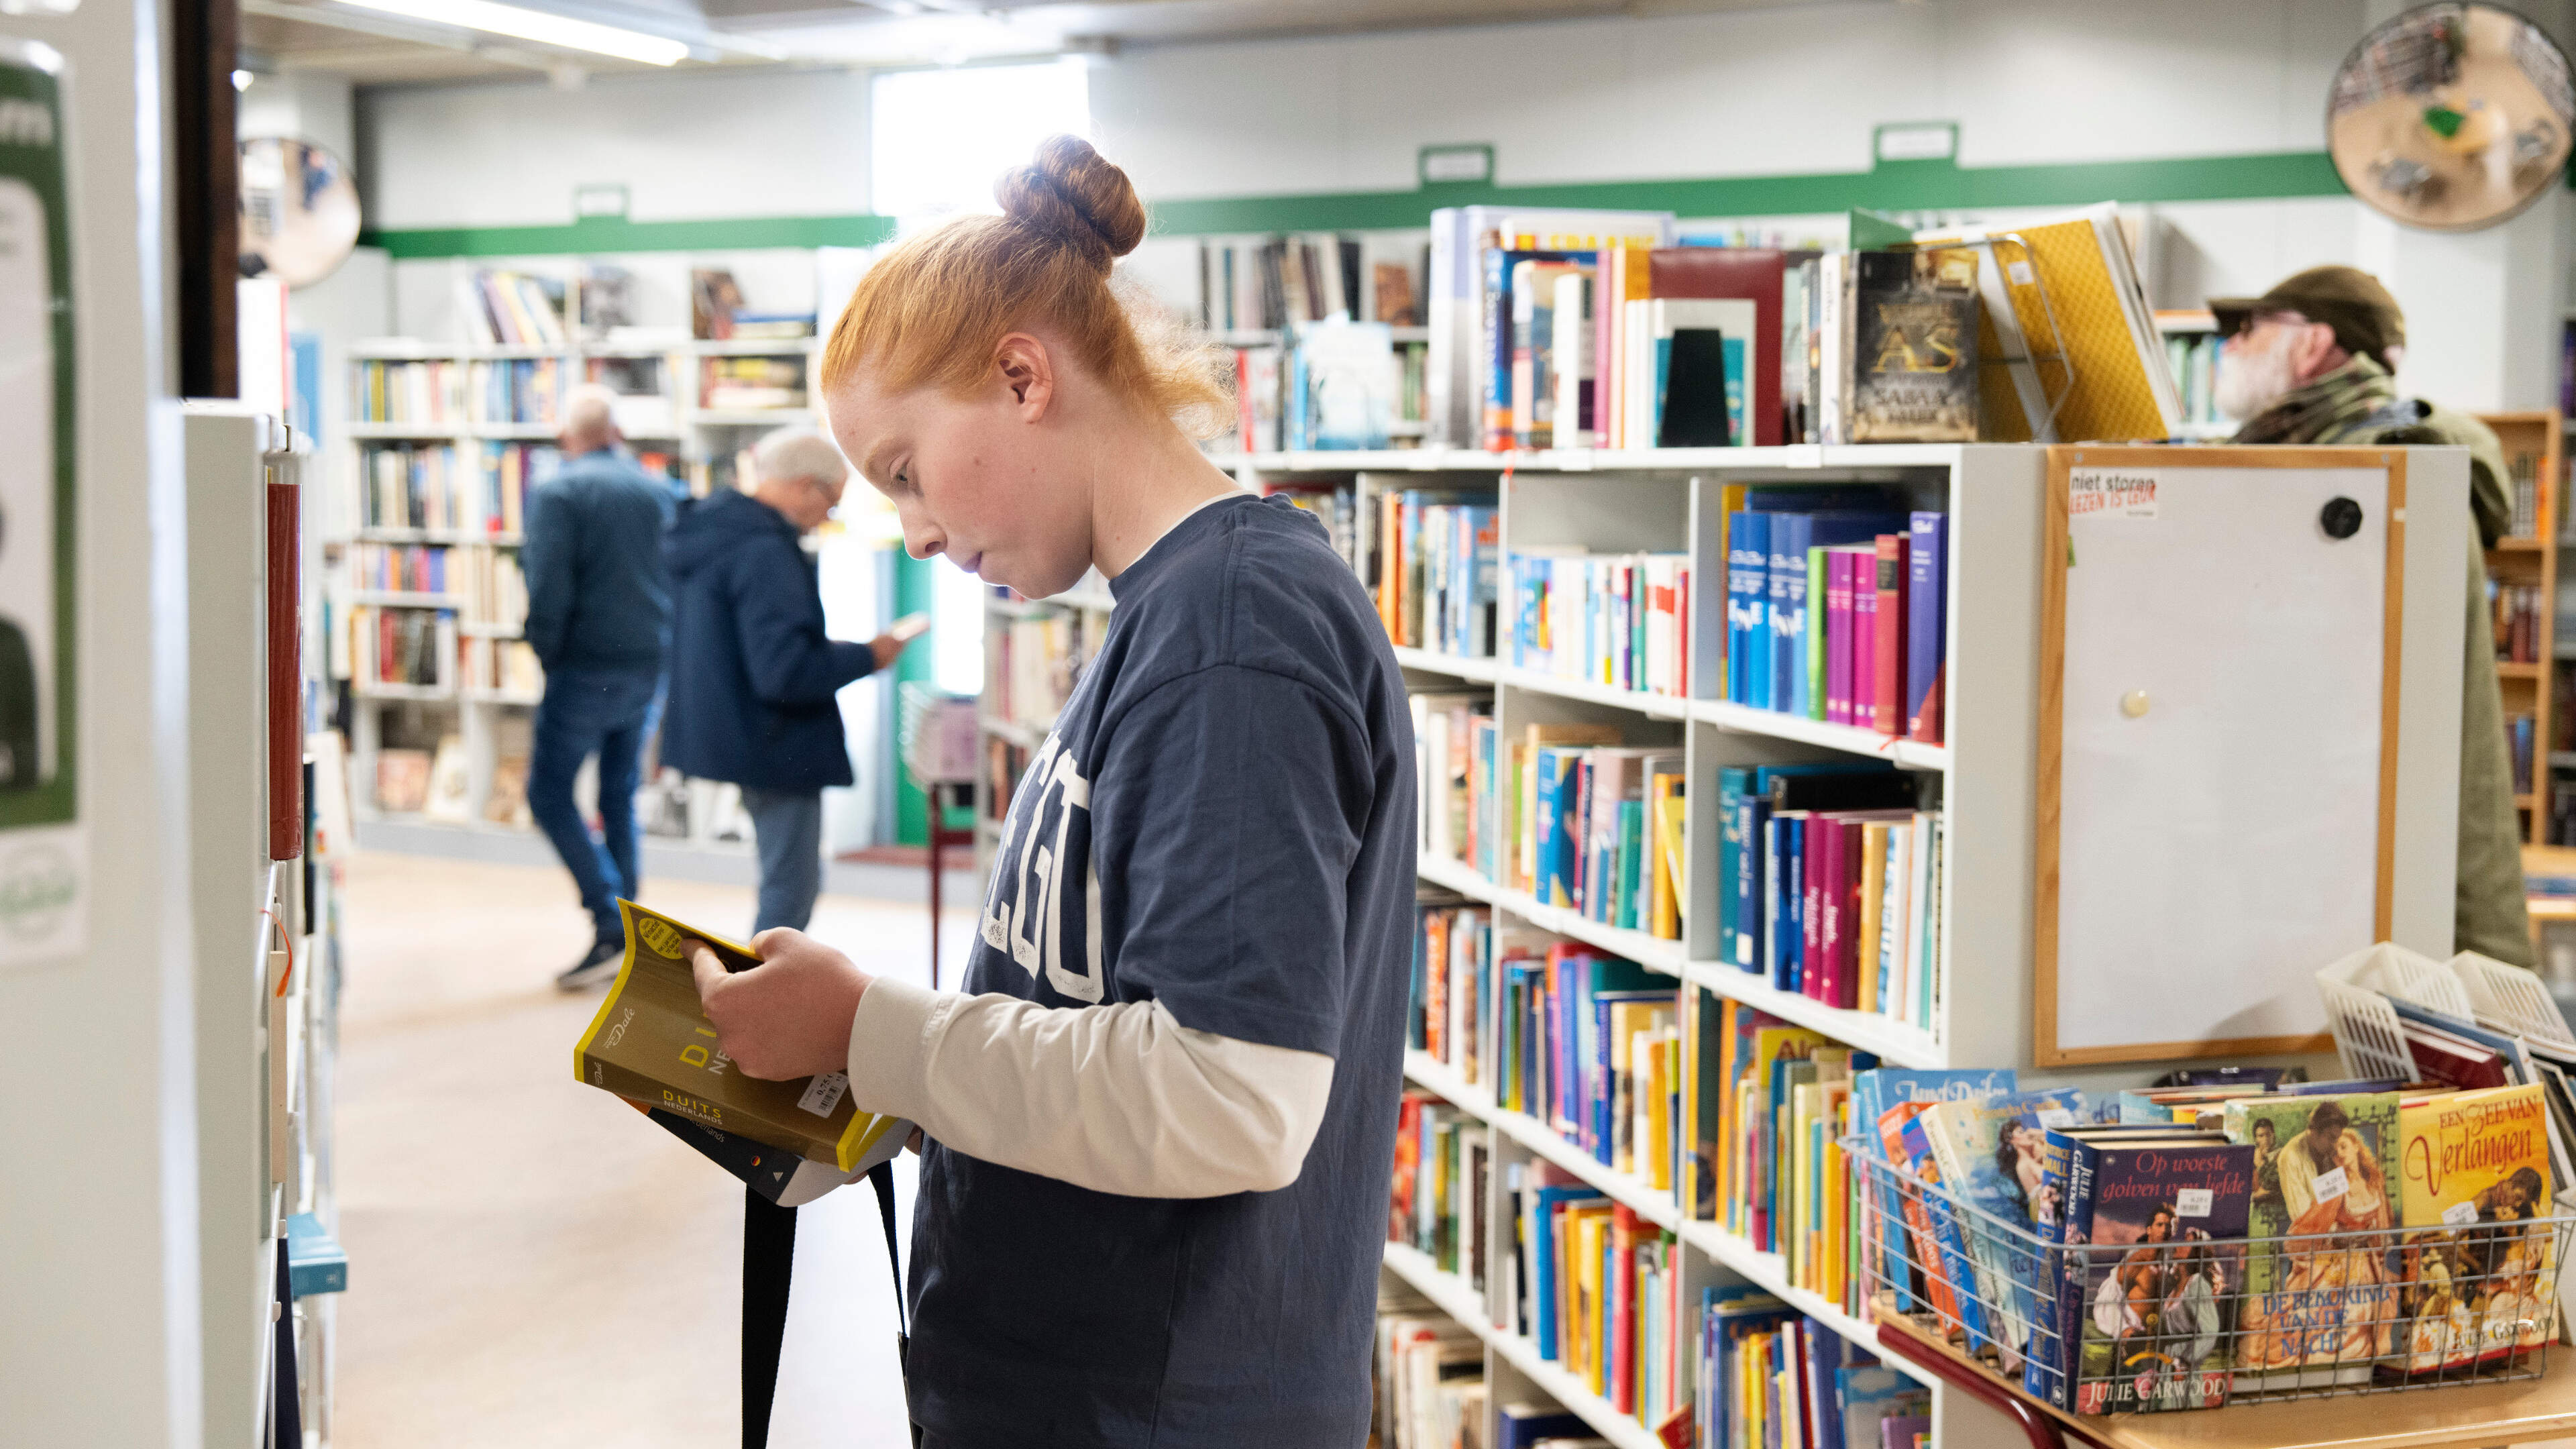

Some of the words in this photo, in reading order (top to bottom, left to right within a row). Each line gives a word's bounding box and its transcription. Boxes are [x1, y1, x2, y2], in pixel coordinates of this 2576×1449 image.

[2072, 474, 2100, 492] niet
[2069, 491, 2105, 515] LEZEN
[604, 1008, 635, 1046] Dale
[663, 1089, 722, 1118] DUITS
[664, 1099, 722, 1125] NEDERLANDS
[2439, 1110, 2465, 1129] EEN
[2466, 1102, 2504, 1136] ZEE
[2506, 1094, 2538, 1121] VAN
[2136, 1150, 2167, 1177] Op
[2172, 1154, 2227, 1173] woeste
[2404, 1126, 2532, 1197] Verlangen
[2068, 1149, 2084, 1216] GARWOOD
[2079, 1164, 2094, 1199] JULIE
[2101, 1175, 2159, 1204] golven
[2205, 1172, 2245, 1201] liefde
[2263, 1295, 2288, 1315] DE
[2086, 1380, 2134, 1408] JULIE
[2137, 1377, 2225, 1401] GARWOOD
